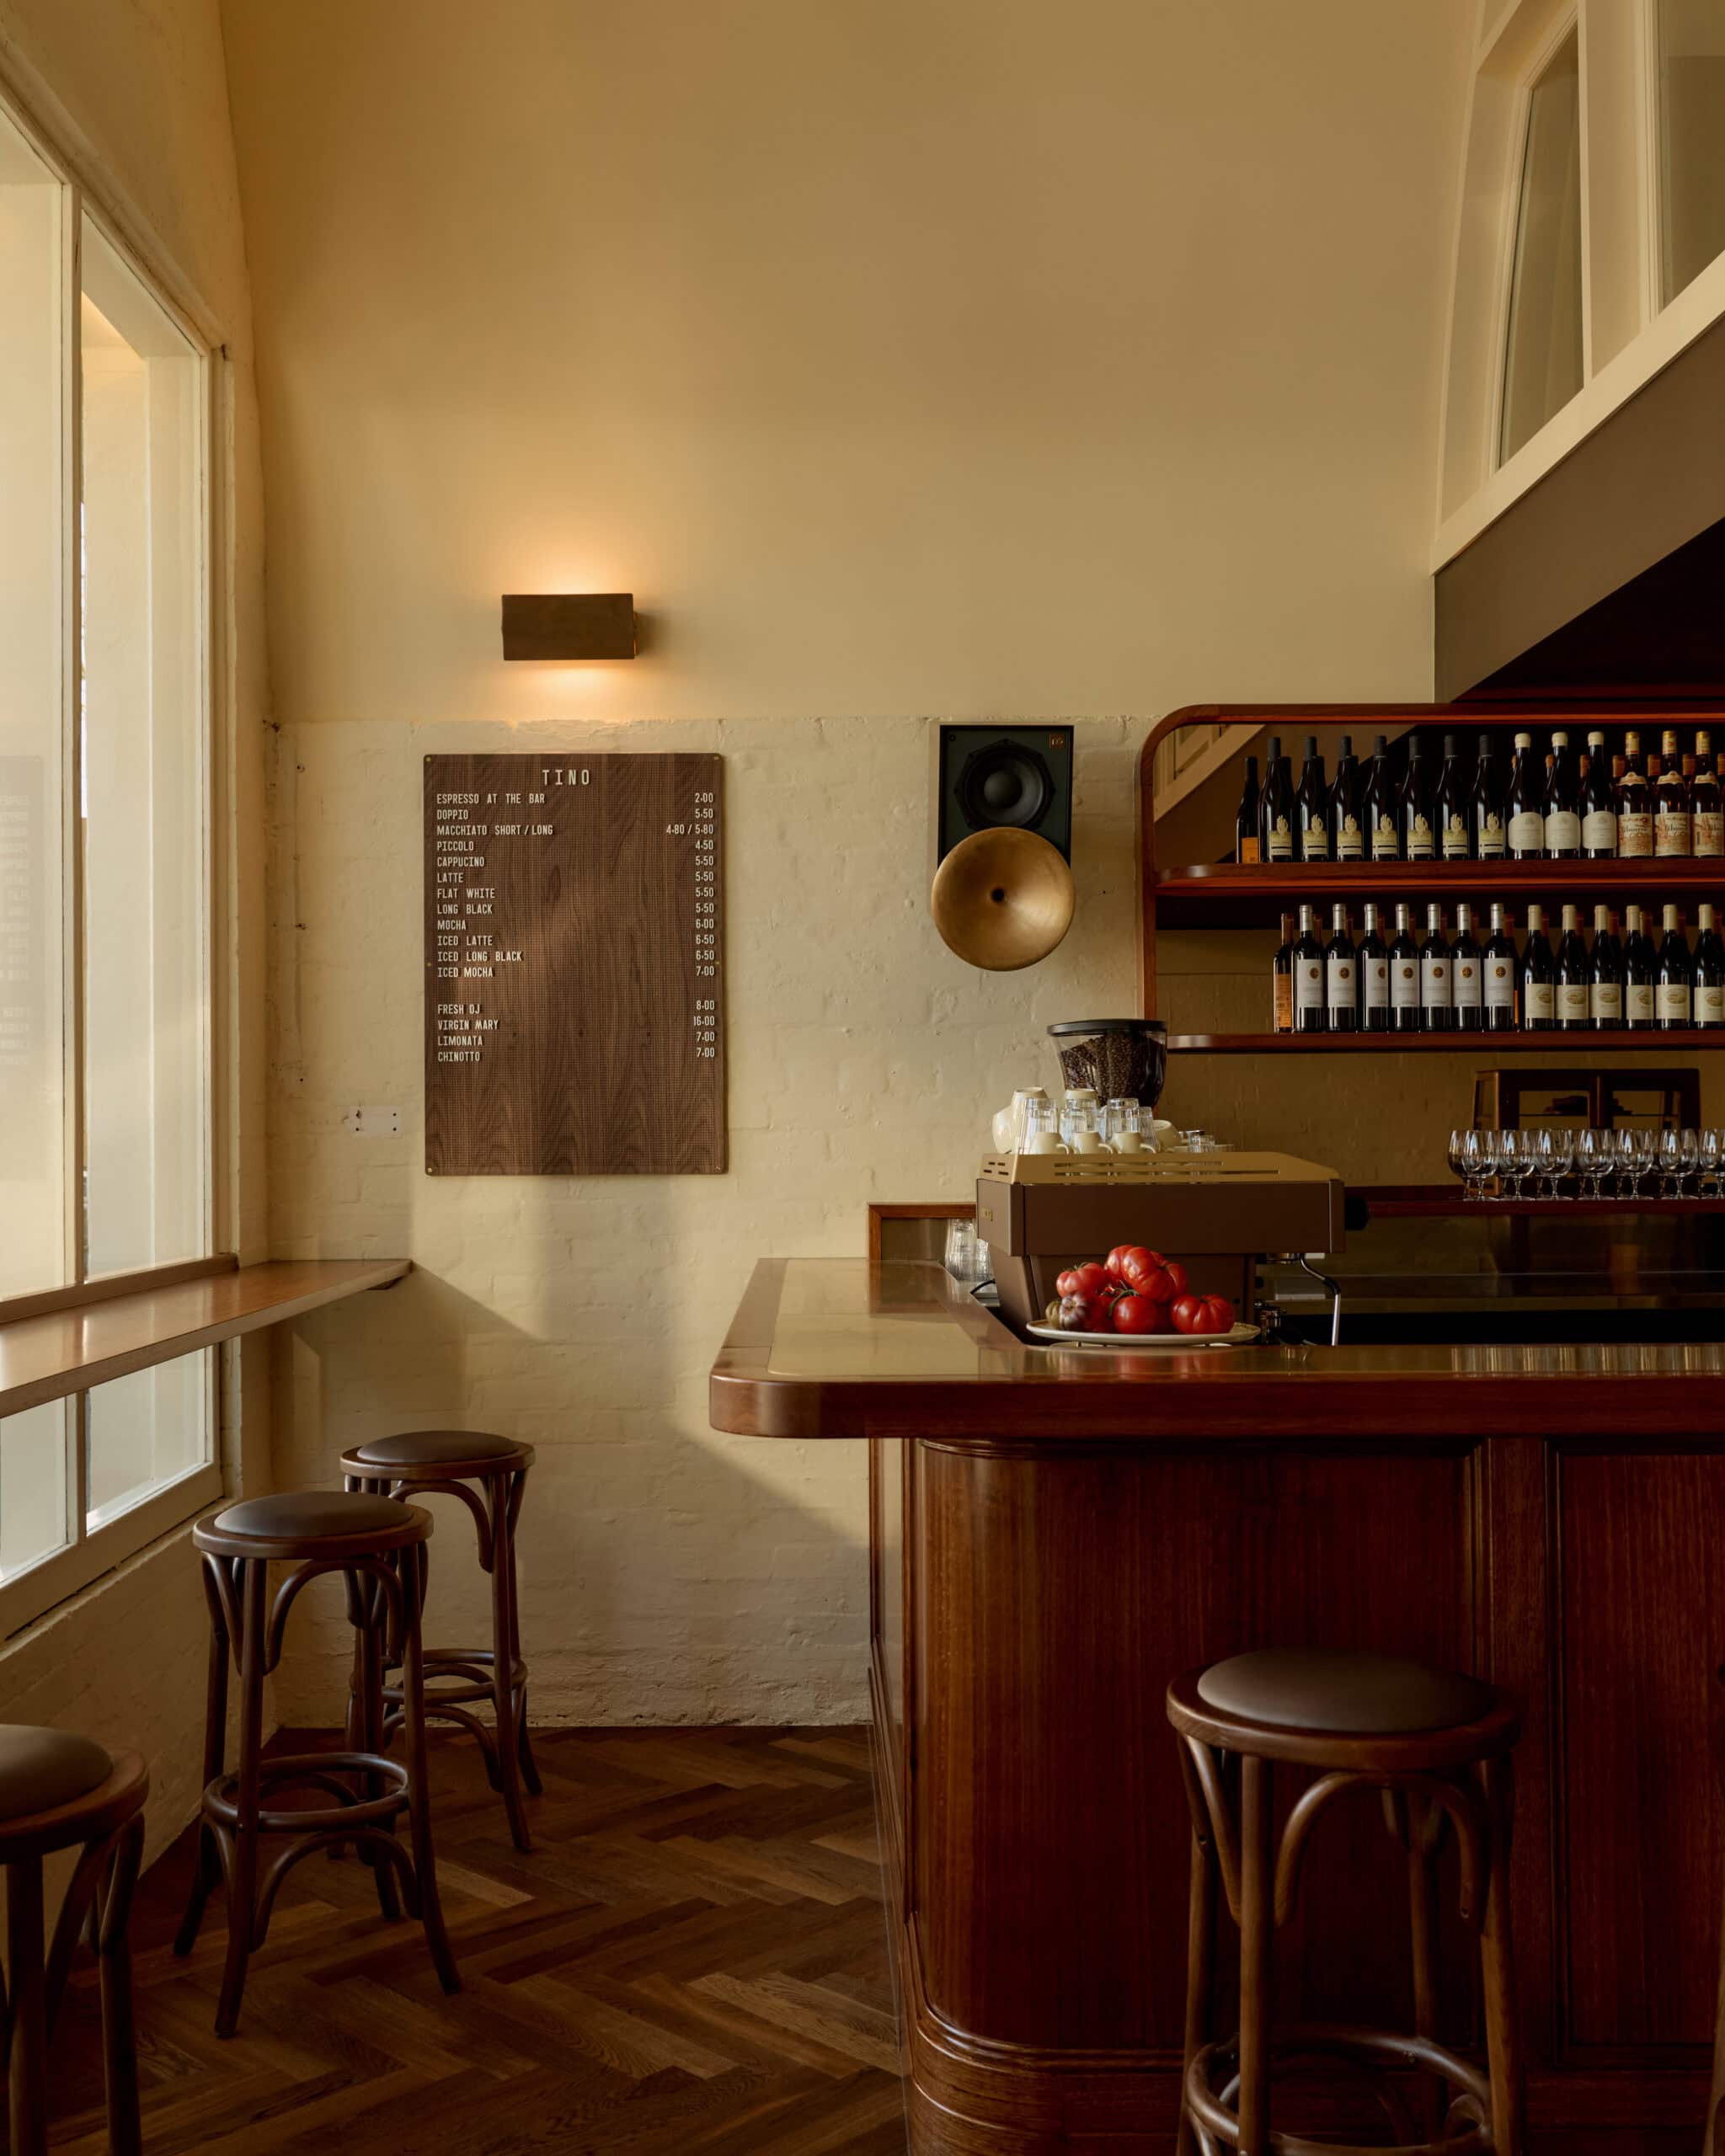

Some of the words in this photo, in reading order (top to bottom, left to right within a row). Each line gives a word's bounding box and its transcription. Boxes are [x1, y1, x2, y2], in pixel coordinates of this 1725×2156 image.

[542, 769, 590, 786] TINO
[436, 793, 479, 804] ESPRESSO
[486, 793, 498, 804] AT
[505, 792, 521, 804] THE
[529, 792, 545, 804] BAR
[436, 808, 468, 820] DOPPIO
[436, 825, 488, 835] MACCHIATO
[436, 841, 474, 851] PICCOLO
[437, 856, 485, 867] CAPPUCINO
[437, 872, 464, 883] LATTE
[437, 888, 458, 899] FLAT
[466, 888, 495, 899] WHITE
[437, 904, 459, 915] LONG
[466, 904, 493, 915] BLACK
[437, 920, 467, 931] MOCHA
[437, 935, 459, 946] ICED
[466, 935, 493, 946] LATTE
[437, 951, 459, 962] ICED
[466, 951, 488, 962] LONG
[495, 951, 521, 962] BLACK
[437, 967, 459, 978] ICED
[463, 966, 493, 978] MOCHA
[437, 1004, 464, 1015] FRESH
[468, 1003, 480, 1015] OJ
[437, 1019, 469, 1031] VIRGIN
[474, 1019, 499, 1030] MARY
[437, 1035, 483, 1047] LIMONATA
[438, 1051, 480, 1062] CHINOTTO
